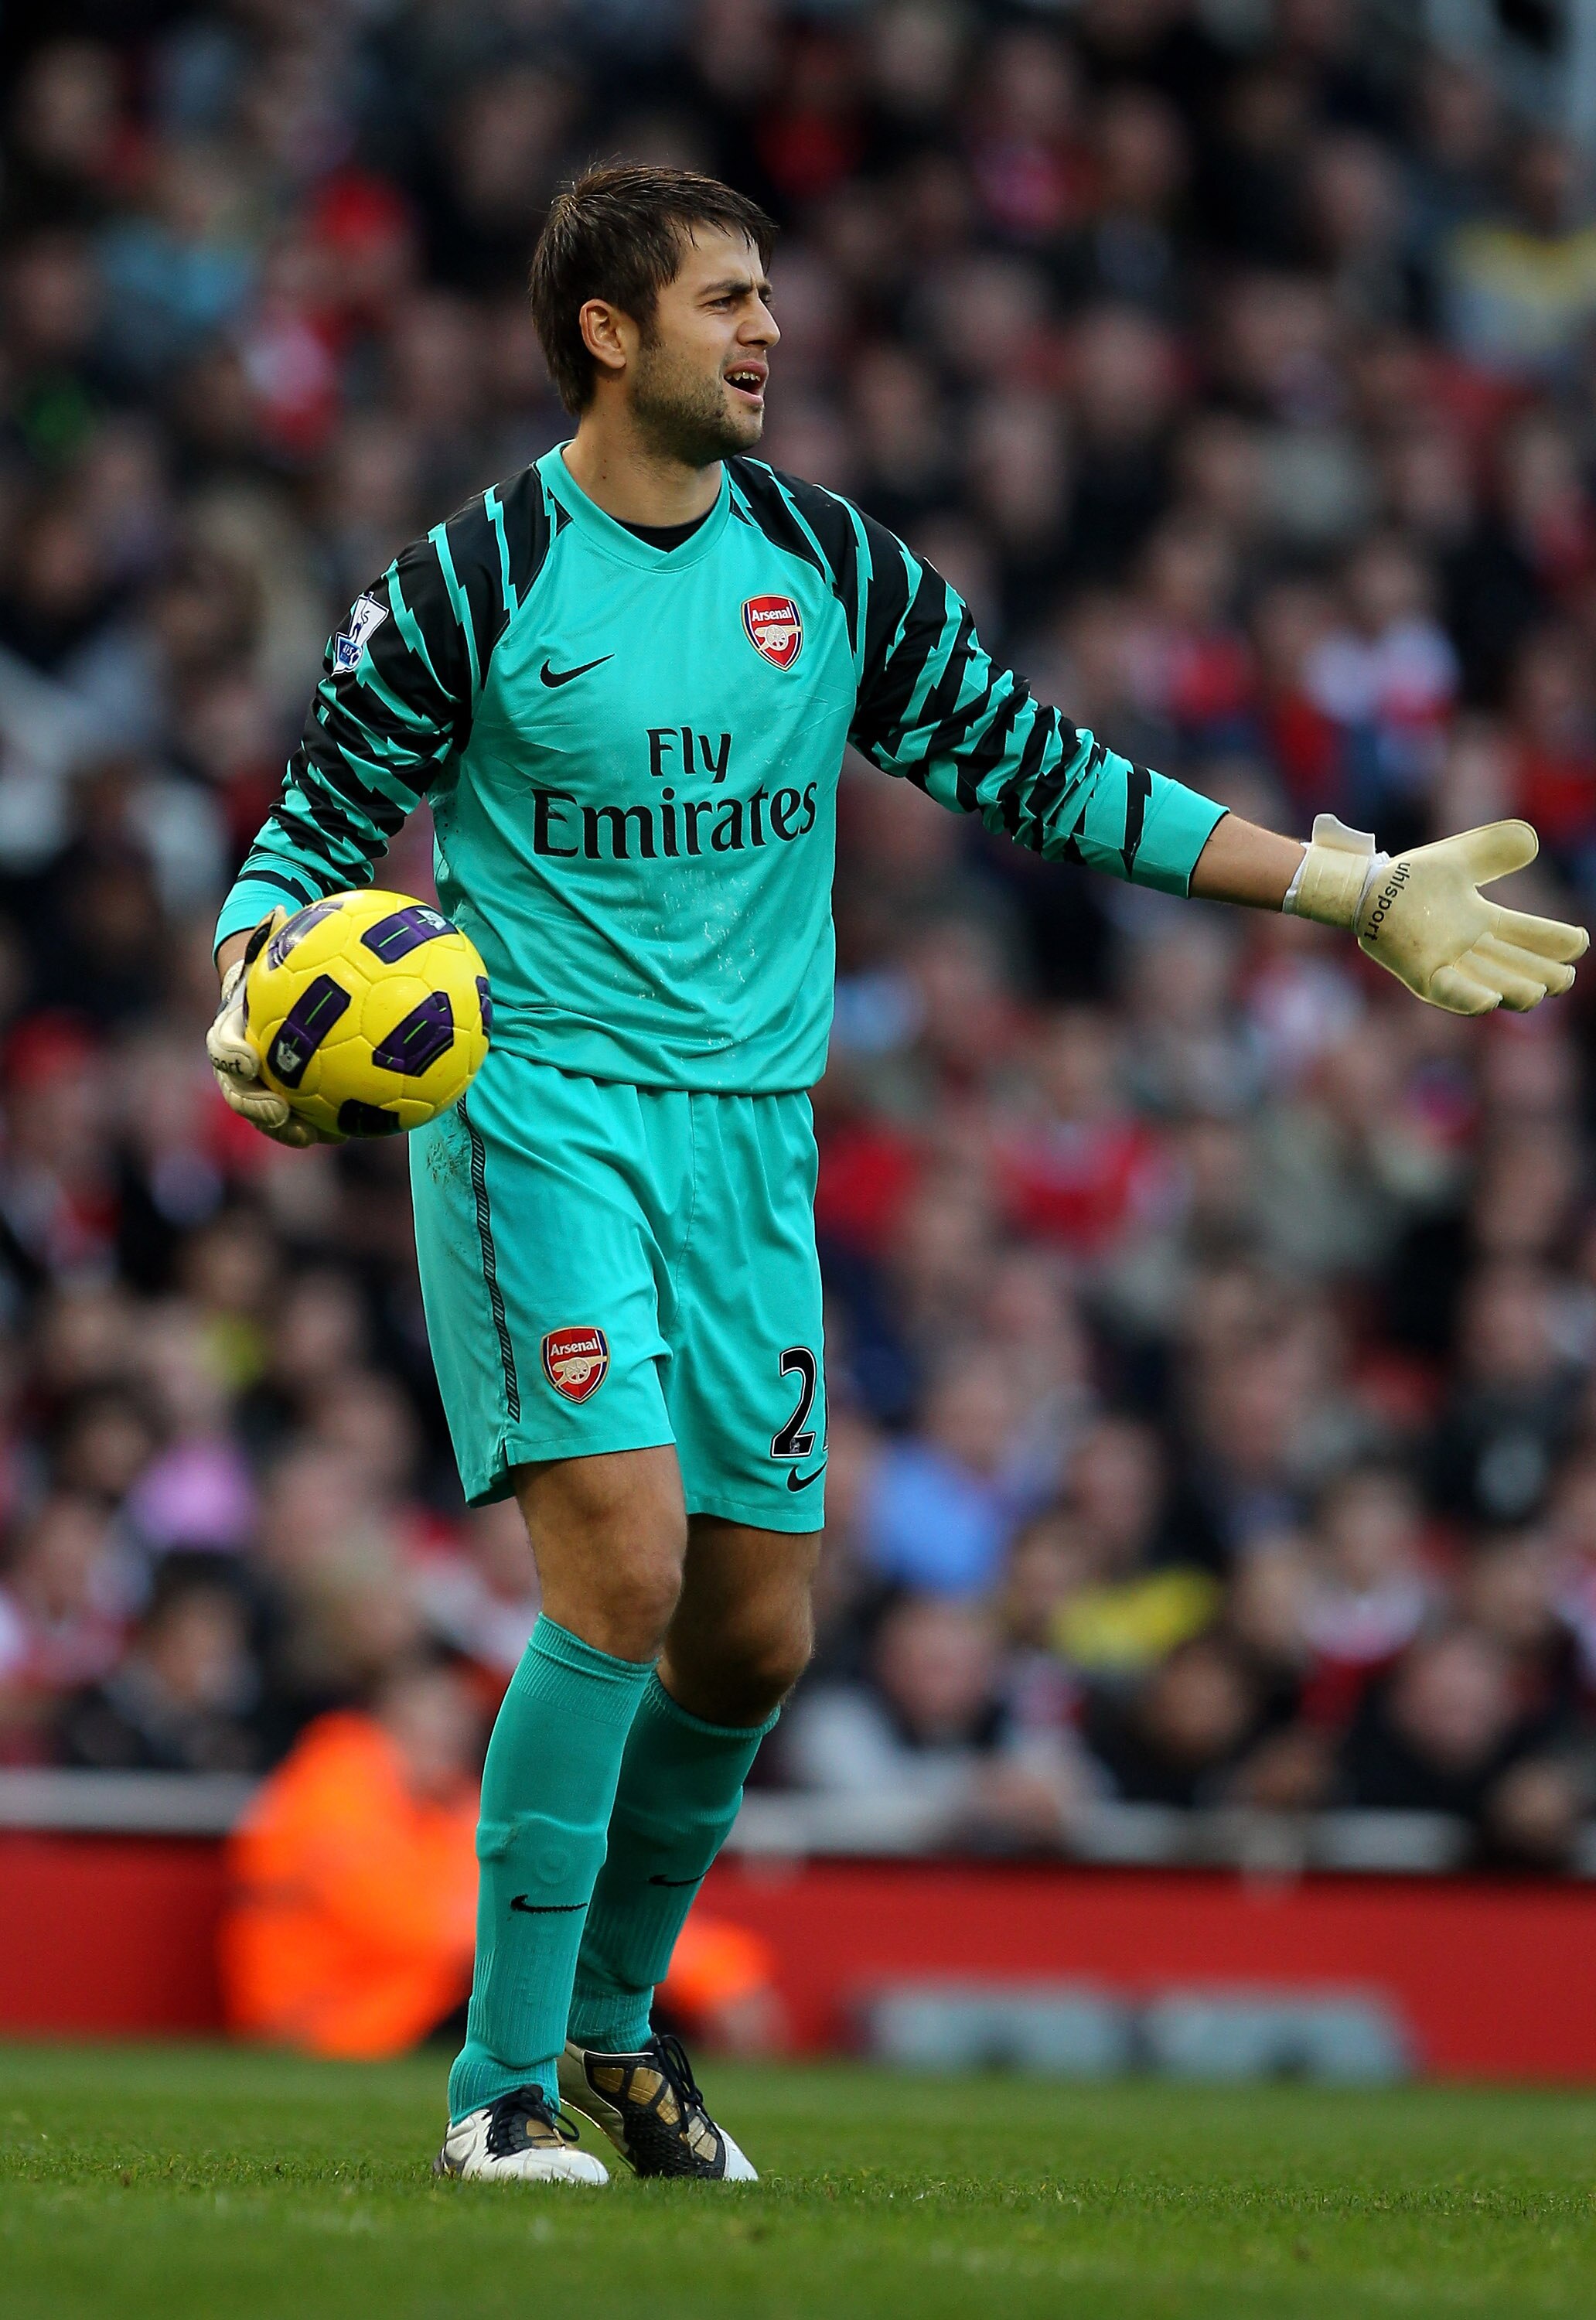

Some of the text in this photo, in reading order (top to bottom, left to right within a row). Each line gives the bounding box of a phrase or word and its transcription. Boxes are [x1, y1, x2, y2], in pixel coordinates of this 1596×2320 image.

[752, 606, 793, 622] Arsenal
[646, 725, 732, 783] Fly
[530, 781, 817, 860] Emirates
[1364, 861, 1411, 941] uhlsport
[550, 1337, 598, 1356] Arsenal
